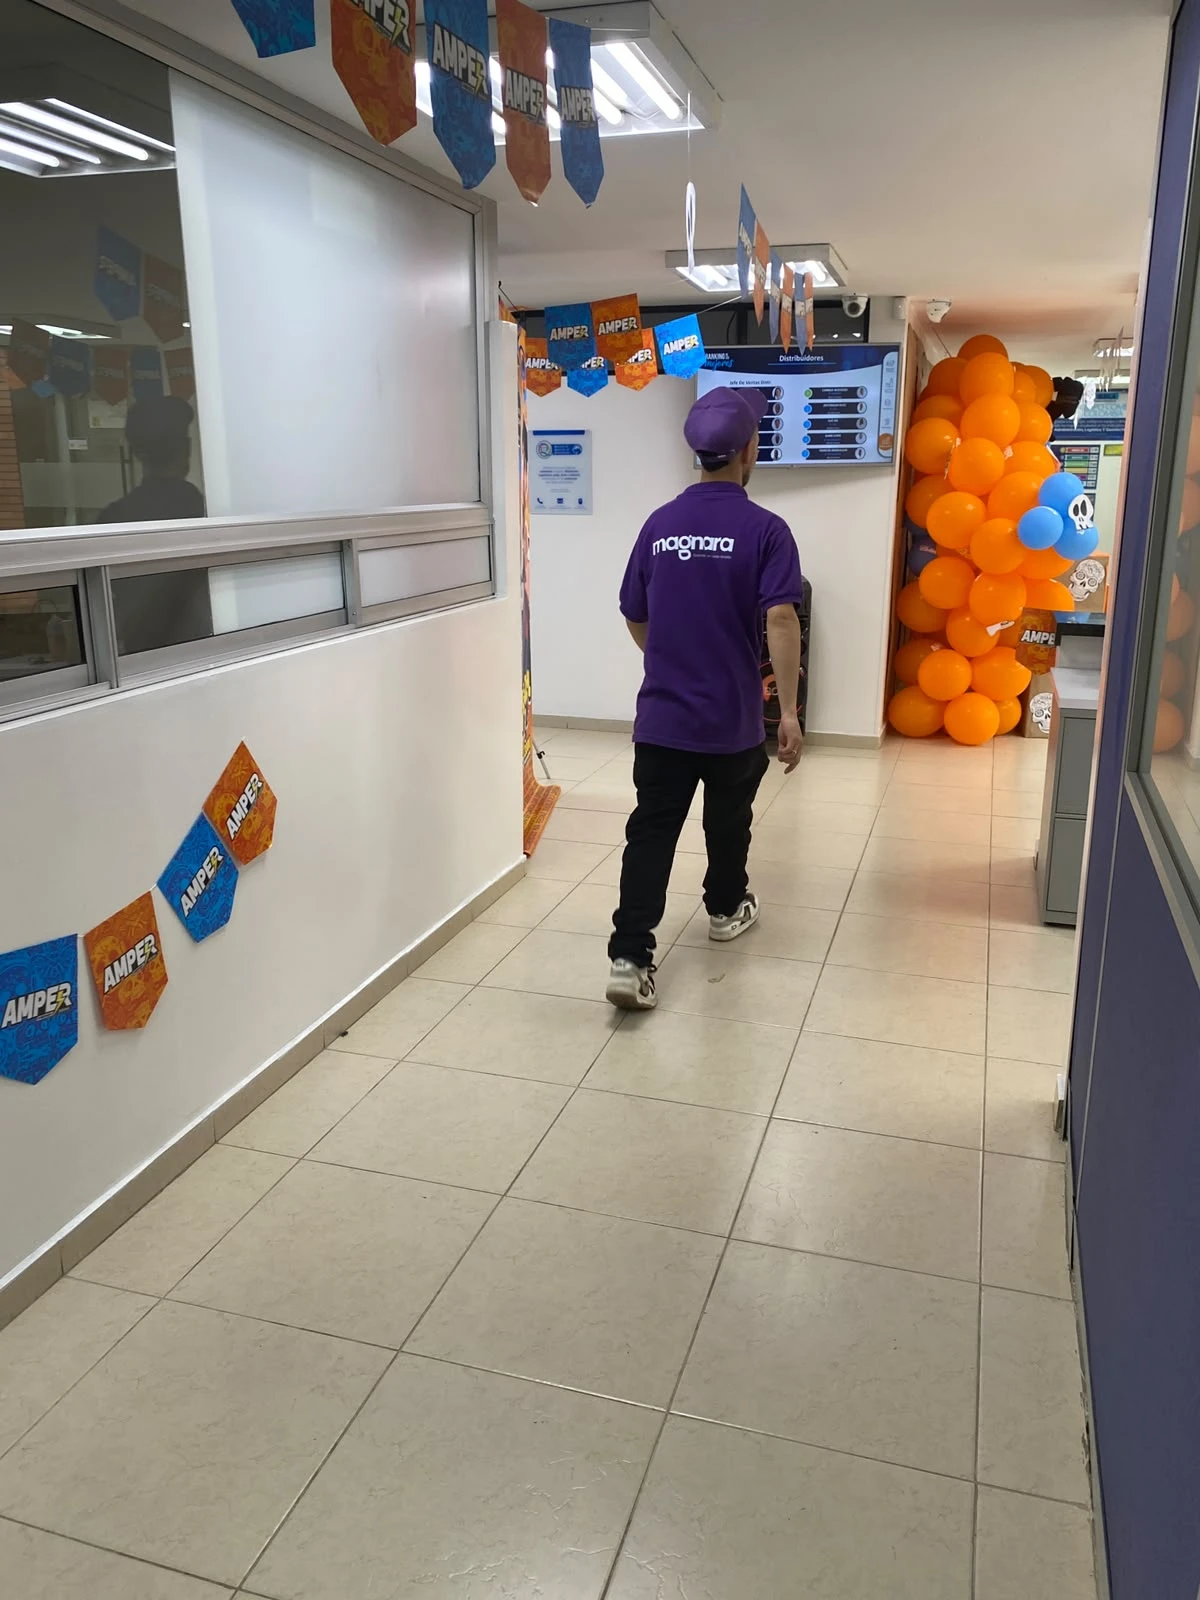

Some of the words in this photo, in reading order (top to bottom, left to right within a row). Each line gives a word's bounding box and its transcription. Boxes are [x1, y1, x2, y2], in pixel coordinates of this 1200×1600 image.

[433, 23, 490, 95] AMPER
[505, 69, 548, 119] AMPER
[560, 86, 597, 122] AMPER
[550, 326, 589, 341] AMPER
[598, 317, 638, 336] AMPER
[663, 335, 699, 356] AMPER
[652, 534, 735, 560] magnara
[1020, 629, 1056, 645] AMPE
[226, 773, 264, 840] AMPER
[180, 846, 224, 917] AMPER
[103, 933, 158, 994] AMPER
[1, 982, 73, 1028] AMPER
